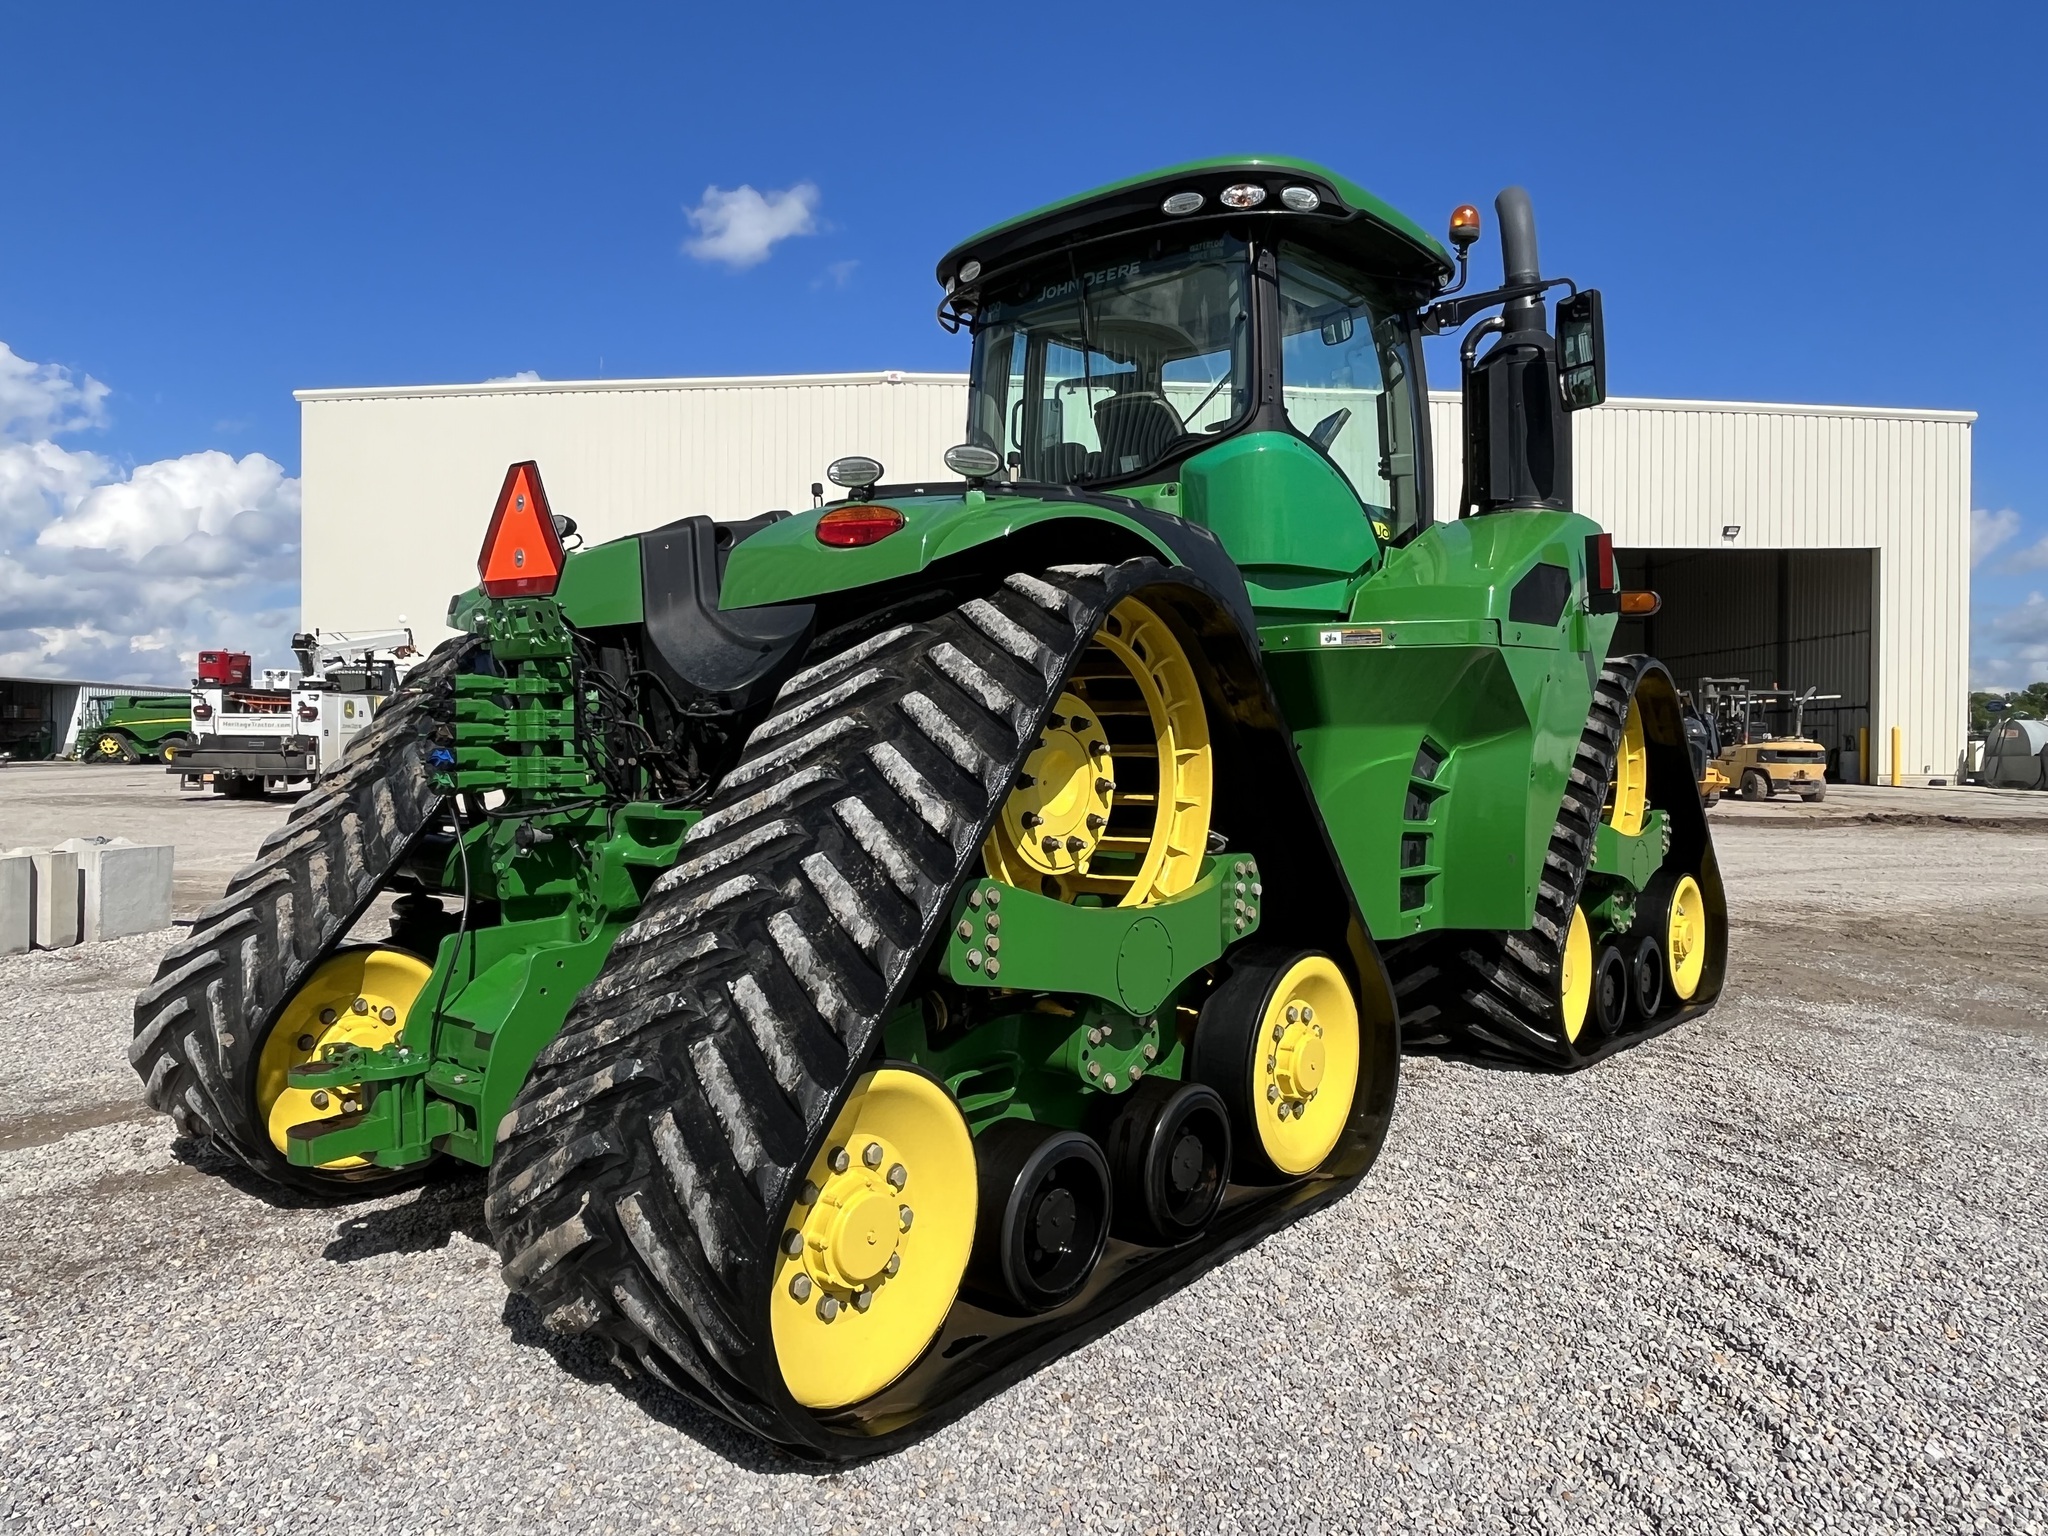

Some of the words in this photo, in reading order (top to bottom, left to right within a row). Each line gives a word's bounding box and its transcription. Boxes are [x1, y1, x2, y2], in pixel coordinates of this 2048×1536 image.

[1037, 277, 1080, 303] JOHN
[1083, 261, 1141, 287] DEERE
[222, 721, 291, 729] HeritageTractor.com
